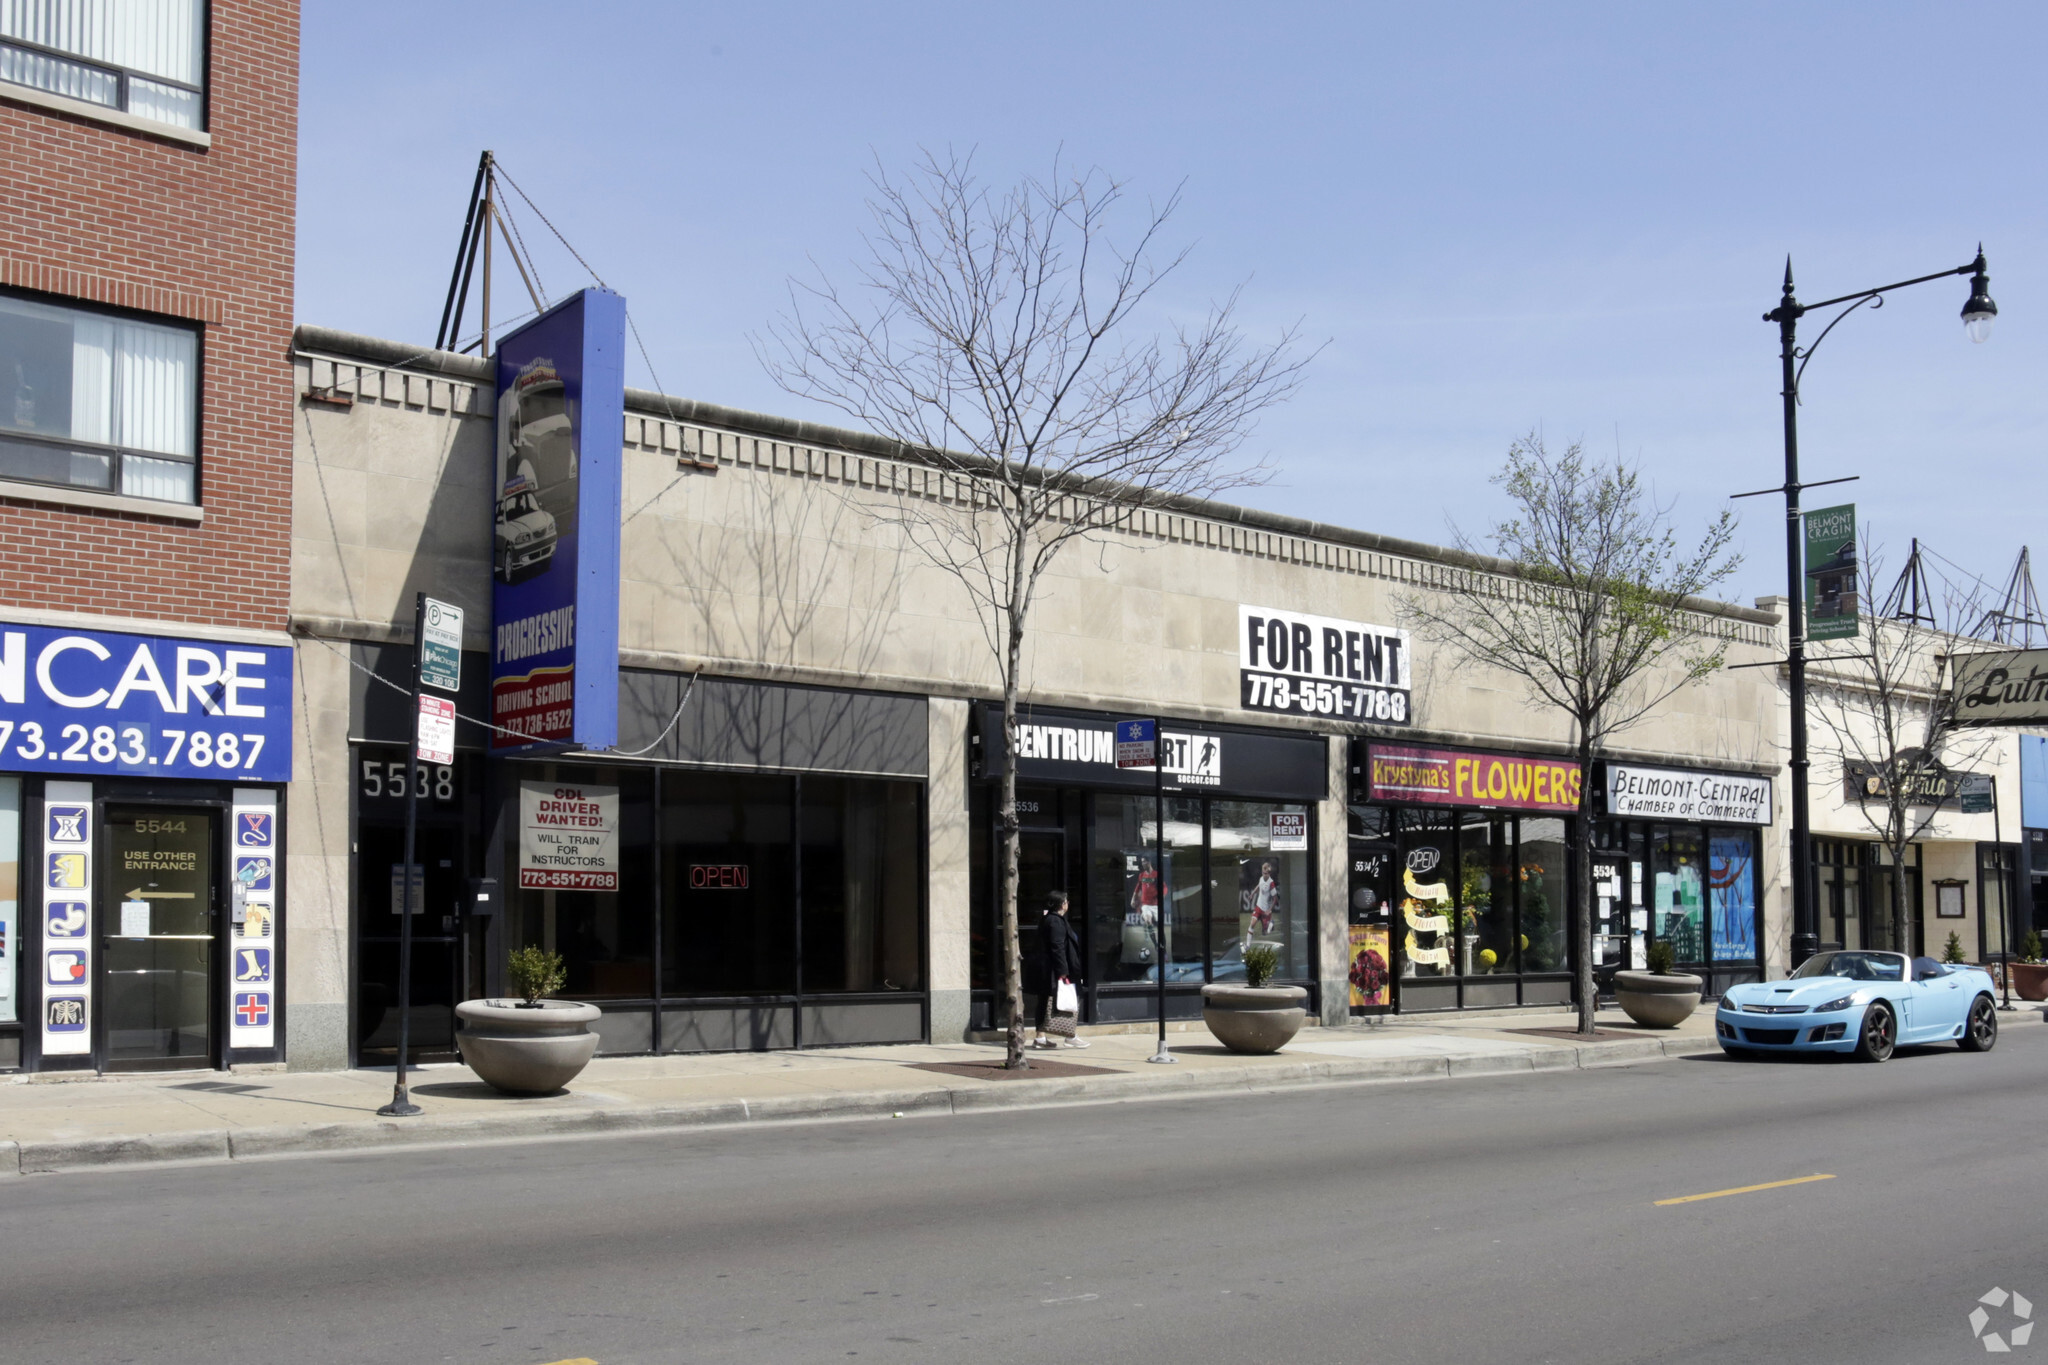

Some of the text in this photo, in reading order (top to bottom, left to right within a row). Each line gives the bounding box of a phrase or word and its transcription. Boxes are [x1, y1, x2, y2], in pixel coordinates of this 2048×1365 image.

[1808, 513, 1852, 530] BELMONT
[1808, 523, 1852, 539] CRAGIN
[497, 605, 574, 664] PROGRESSIVE
[1248, 615, 1403, 685] FOR RENT
[432, 675, 443, 686] 320
[497, 680, 572, 714] DRIVING SCHOOL
[1247, 674, 1406, 722] 773-551-7788
[506, 708, 572, 738] 773 736-5522
[363, 760, 453, 800] 5538
[1177, 774, 1221, 786] soccer.com
[1373, 758, 1582, 805] Krystyna's FLOWERS
[1611, 770, 1765, 804] BELMONT-CENTRAL
[554, 788, 586, 801] CDL
[540, 801, 600, 814] DRIVER
[1016, 801, 1039, 813] 5536
[1618, 795, 1758, 819] CHAMBER OF COMMERCE
[135, 820, 187, 833] 5544
[536, 813, 603, 827] WANTED!
[1276, 815, 1299, 825] FOR
[1273, 825, 1303, 835] RENT
[538, 834, 600, 845] WILL TRAIN
[124, 851, 196, 861] USE OTHER
[557, 846, 578, 855] FOR
[125, 861, 195, 871] ENTRANCE
[531, 855, 605, 867] INSTRUCTORS
[1407, 851, 1438, 869] OPEN
[692, 866, 746, 888] OPEN
[1593, 865, 1616, 878] 5534
[523, 872, 615, 887] 773-551-7788
